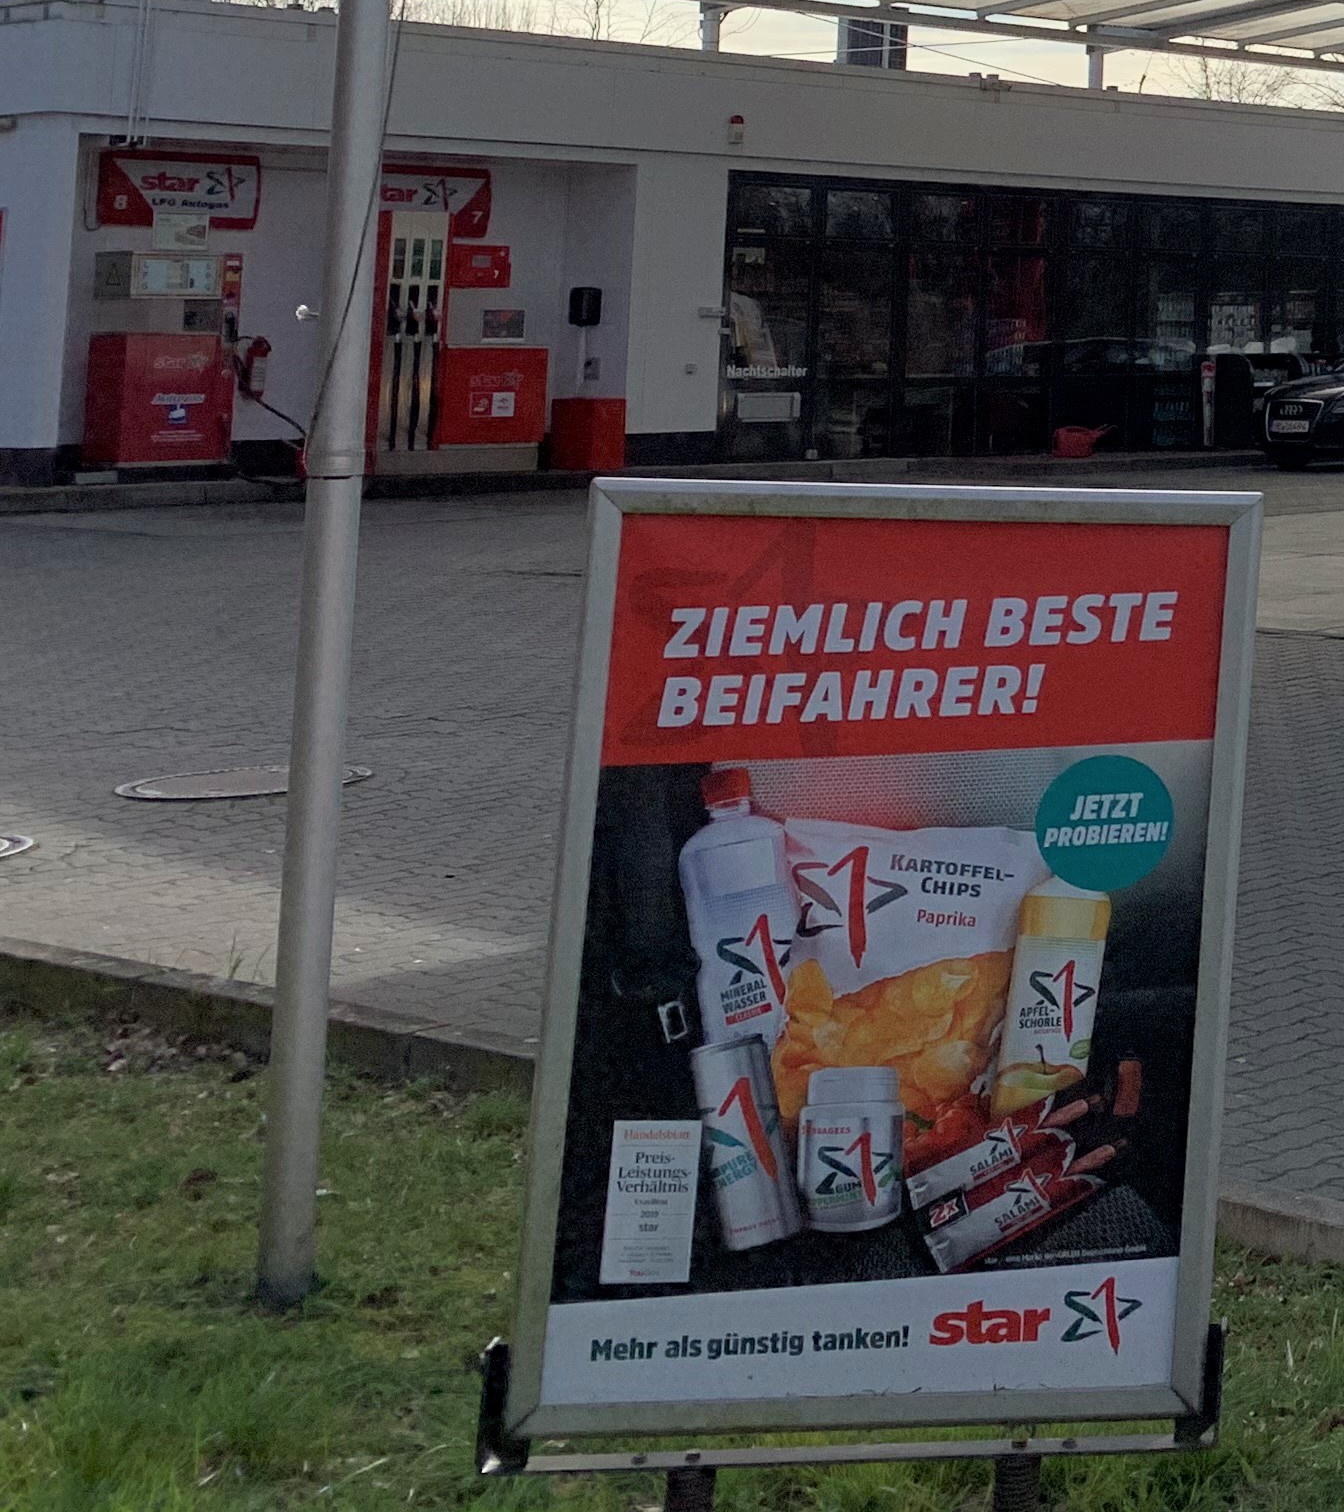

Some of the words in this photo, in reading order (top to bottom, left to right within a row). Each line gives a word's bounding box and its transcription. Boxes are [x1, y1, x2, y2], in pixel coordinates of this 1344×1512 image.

[140, 171, 200, 192] star
[113, 194, 128, 210] 8
[380, 185, 418, 202] tar
[471, 211, 483, 224] 7
[726, 364, 808, 378] Nachtschalter
[663, 599, 969, 659] ZIEMLICH
[984, 591, 1179, 649] BESTE
[656, 664, 1046, 728] BEIFAHRER!
[1070, 792, 1144, 820] JETZT
[1043, 821, 1169, 848] PROBIEREN!
[921, 877, 981, 897] CHIPS
[917, 909, 976, 927] Paprika
[721, 979, 767, 1002] MINERAL
[722, 991, 767, 1014] WASSER
[1019, 1006, 1055, 1017] APFEL-
[1019, 1017, 1062, 1029] SCHORLE
[624, 1129, 689, 1140] Handelsblatt
[635, 1151, 675, 1164] Preis-
[970, 1147, 1013, 1175] SALAMI
[618, 1166, 691, 1181] Leistungs-
[617, 1180, 689, 1193] Verhältnis
[835, 1181, 862, 1194] GUM
[994, 1195, 1040, 1226] SALAMI
[639, 1223, 659, 1232] star
[591, 1336, 658, 1361] Mehr
[665, 1334, 702, 1358] als
[707, 1330, 805, 1359] günstig
[812, 1324, 910, 1352] tanken!
[929, 1301, 1051, 1347] star
